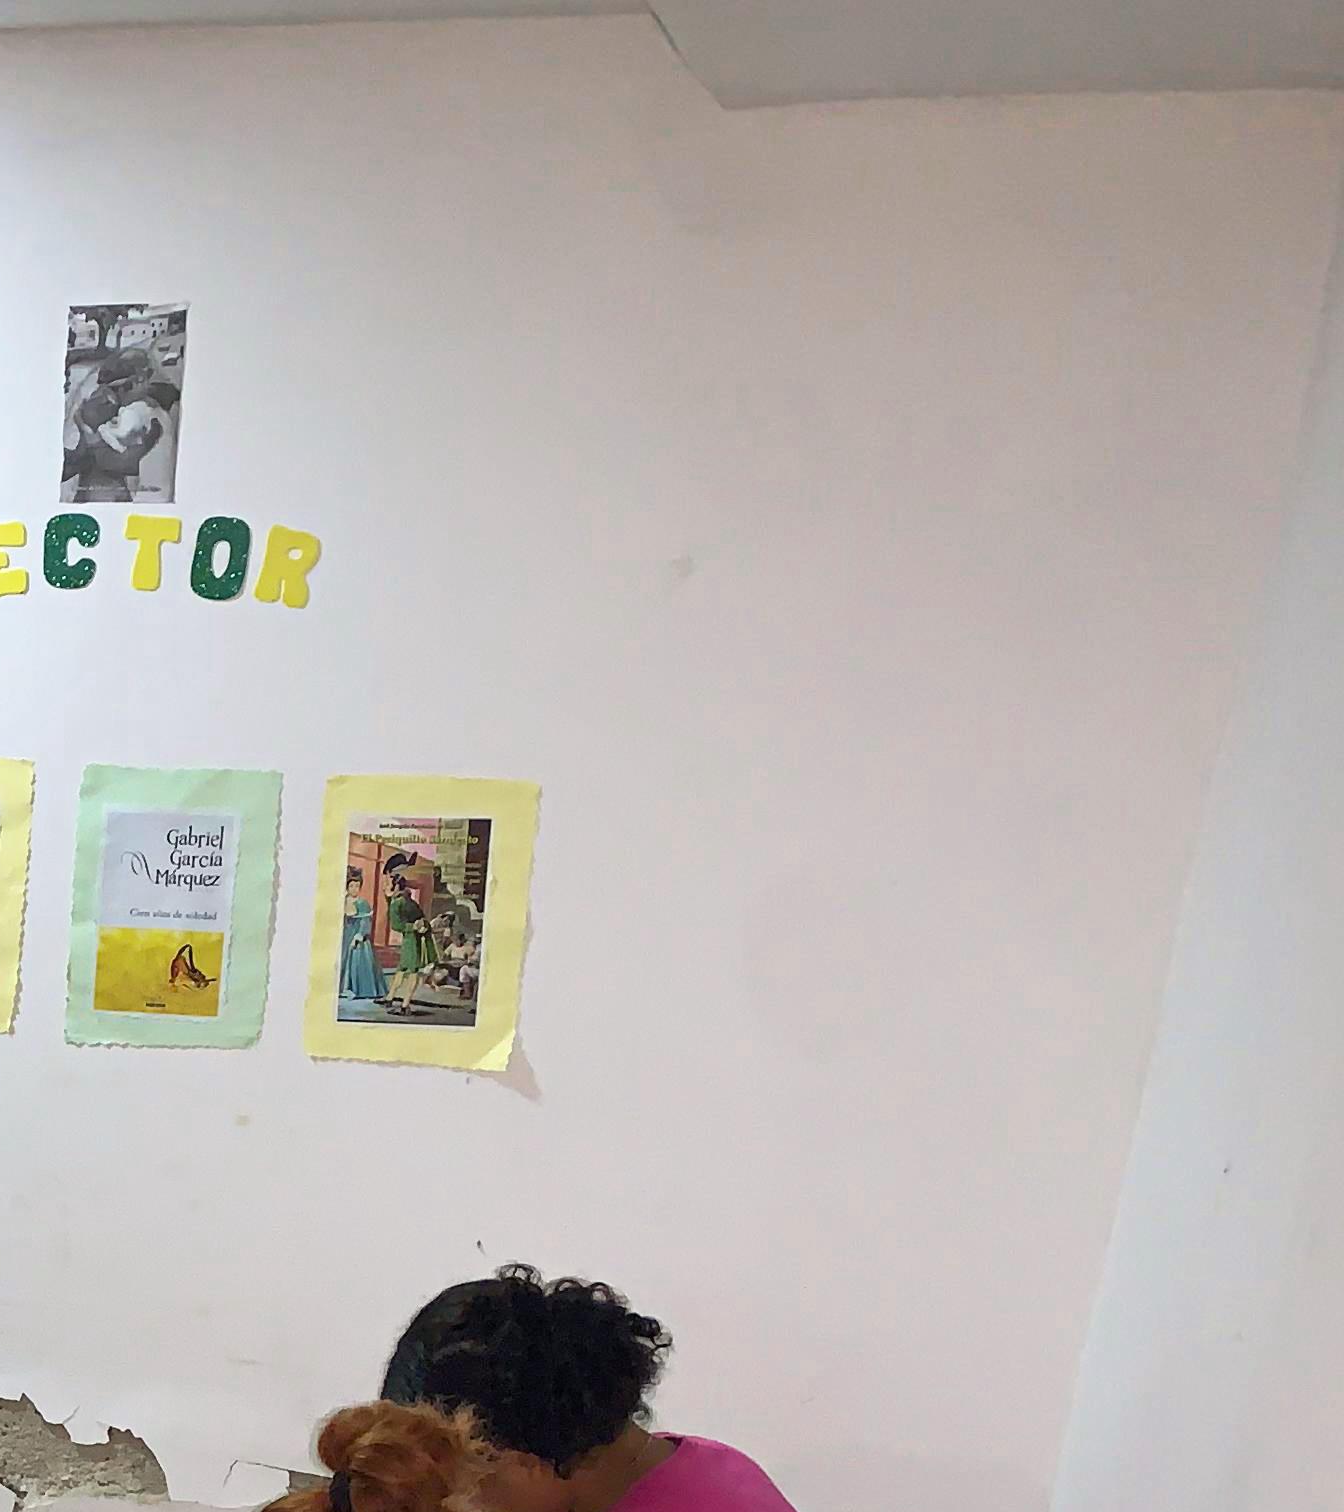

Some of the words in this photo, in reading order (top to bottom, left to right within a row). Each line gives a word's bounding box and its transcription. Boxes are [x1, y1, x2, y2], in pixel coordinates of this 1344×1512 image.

[166, 825, 225, 850] Gabriel
[169, 849, 223, 870] García
[155, 868, 221, 892] Márquez
